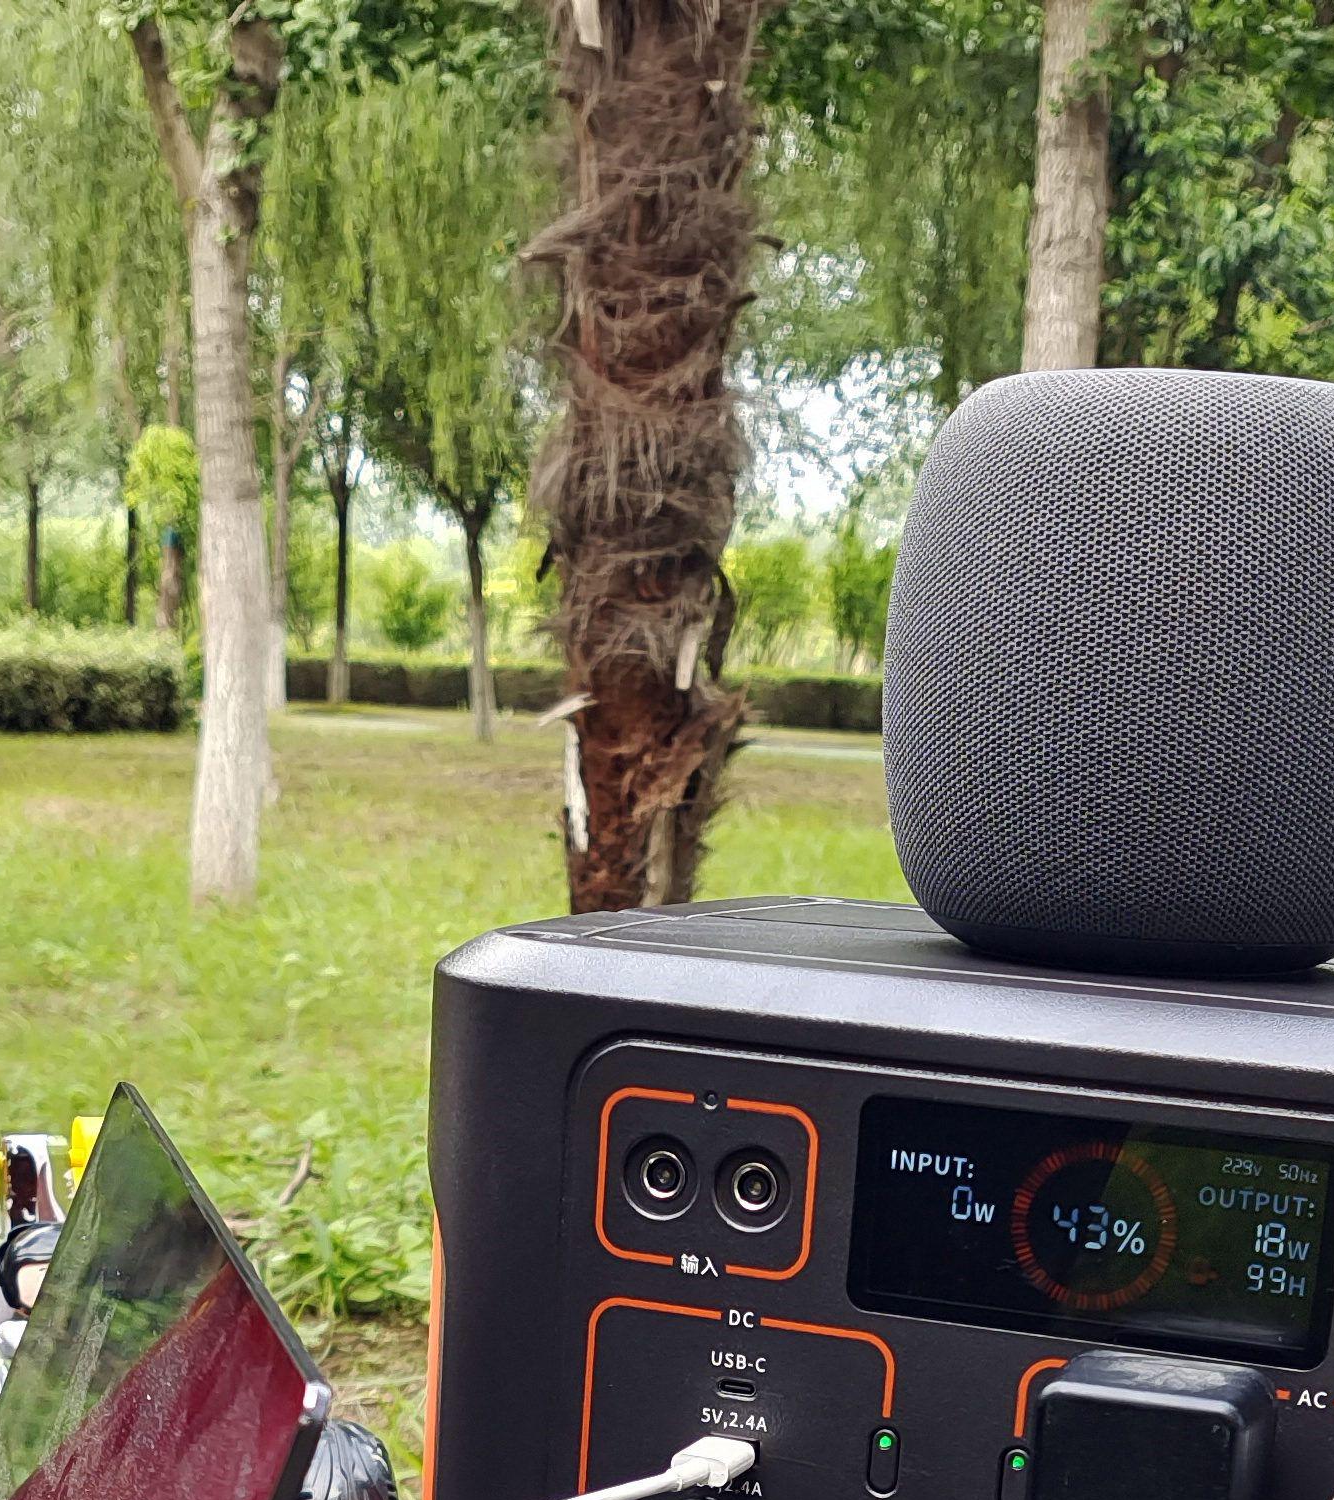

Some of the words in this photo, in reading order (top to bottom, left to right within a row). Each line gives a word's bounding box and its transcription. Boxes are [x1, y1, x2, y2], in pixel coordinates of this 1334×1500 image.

[891, 1149, 974, 1178] INPUT:
[1279, 1164, 1318, 1184] 50Hz
[952, 1186, 995, 1223] 0W
[1198, 1186, 1315, 1217] OUTPUT:
[1053, 1204, 1145, 1254] 43%
[1255, 1223, 1310, 1260] 18W
[680, 1253, 718, 1277] 输入
[1247, 1264, 1306, 1296] 99H
[729, 1309, 755, 1328] DC
[711, 1350, 767, 1373] USB-C
[1296, 1389, 1328, 1409] AC
[701, 1407, 767, 1432] 5V,2.4A
